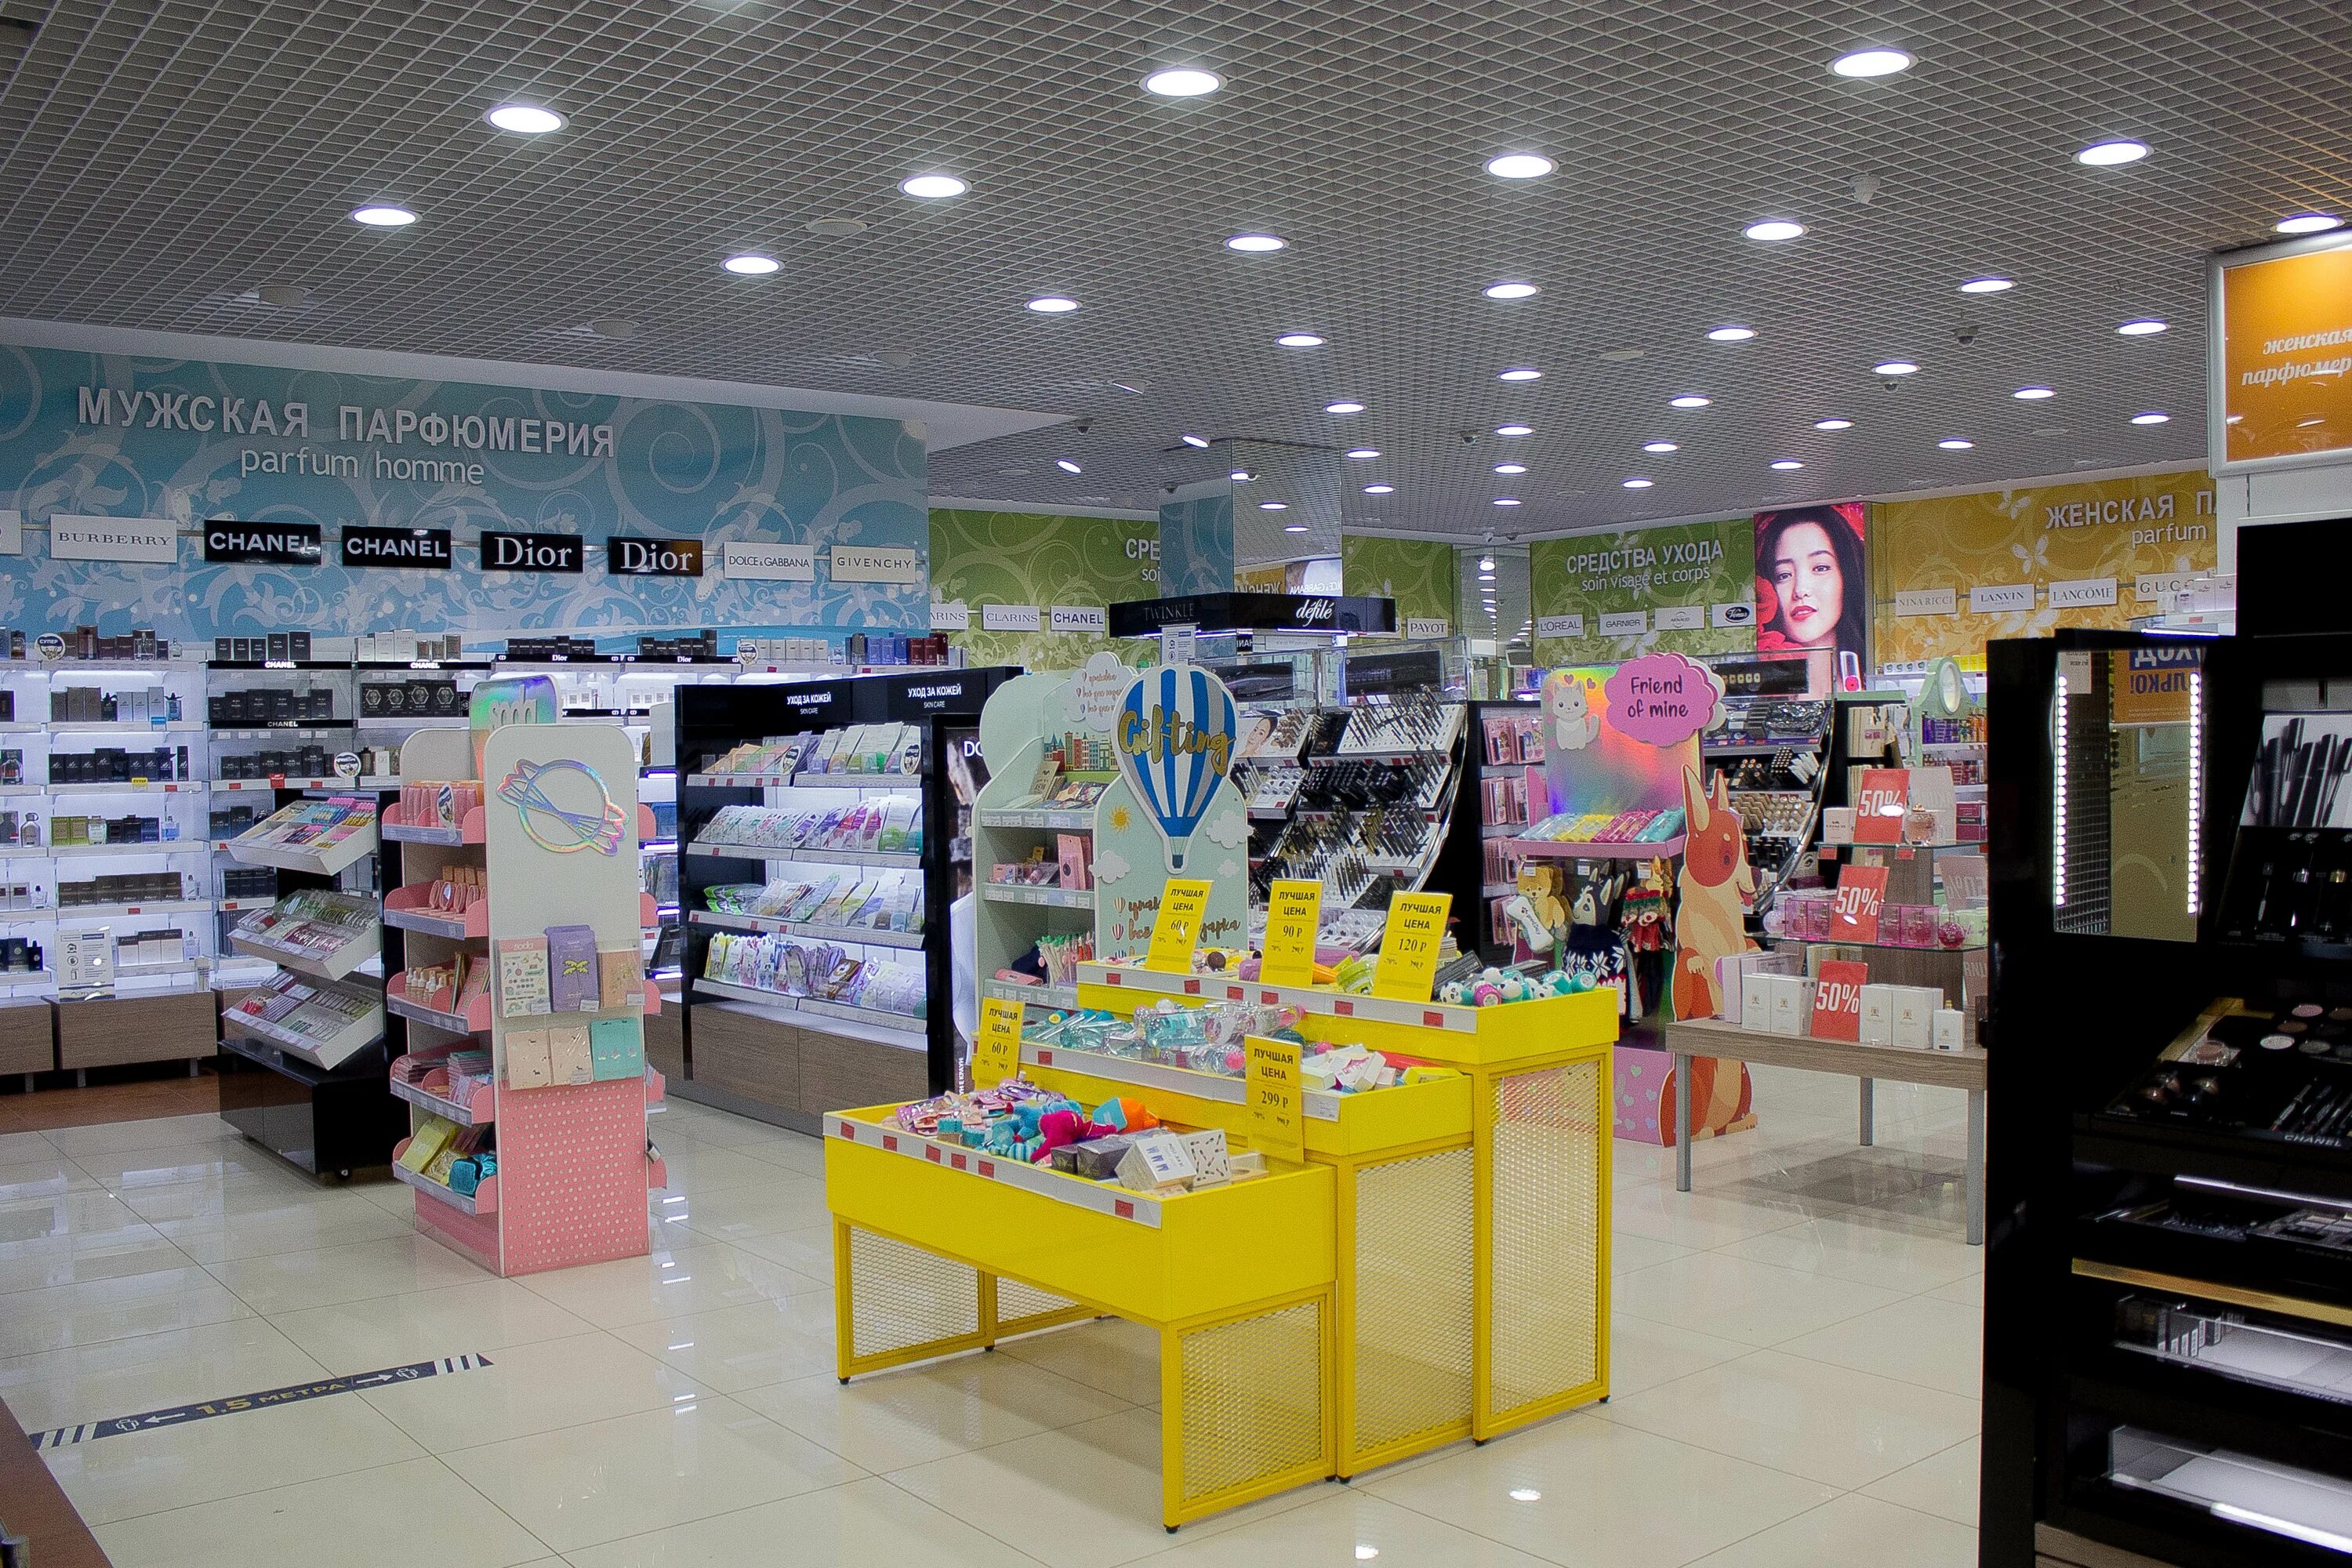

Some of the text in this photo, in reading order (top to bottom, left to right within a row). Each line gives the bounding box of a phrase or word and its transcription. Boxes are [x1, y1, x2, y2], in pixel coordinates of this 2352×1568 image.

[2262, 327, 2352, 355] женская
[78, 387, 615, 457] МУЖСКАЯ ПАРФЮМЕРИЯ
[241, 447, 485, 485] parfum homme
[2045, 495, 2175, 529] ЖЕНСКАЯ
[59, 532, 172, 546] BURBERRY
[209, 532, 315, 552] CHANEL
[2132, 522, 2207, 548] parfum
[347, 537, 448, 557] CHANEL
[494, 537, 573, 568] Dior
[620, 542, 694, 572] Dior
[837, 557, 912, 570] GIVENCHY
[1567, 539, 1724, 575] СРЕДСТВА УХОДА
[1581, 565, 1711, 591] soin visage et corps
[1980, 590, 2025, 603] LANVIN
[2053, 586, 2114, 602] LANCÔME
[1898, 596, 1953, 608] NINA RICCI
[985, 612, 1039, 623] CLARINS
[1054, 612, 1104, 625] CHANEL
[1144, 602, 1195, 621] TWINKLE
[1296, 599, 1335, 626] défilé
[1410, 622, 1446, 633] PAYOT
[265, 660, 297, 669] CHANEL
[410, 661, 441, 670] CHANEL
[552, 654, 568, 662] Dior
[677, 655, 692, 664] Dior
[908, 683, 961, 699] УХОД ЗА КОЖЕЙ
[1630, 676, 1683, 695] Friend
[787, 691, 832, 706] УХОД ЗА КОЖЕЙ
[1627, 699, 1690, 718] of mine
[1117, 703, 1236, 778] Gifting
[1858, 789, 1906, 818] 50%
[1170, 888, 1204, 898] ЛУЧШАЯ
[1279, 891, 1316, 901] ЛУЧШАЯ
[1172, 902, 1194, 912] ЦЕНА
[1399, 902, 1442, 915] ЛУЧШАЯ
[1835, 886, 1880, 916] 50%
[1283, 906, 1307, 916] ЦЕНА
[1171, 919, 1181, 931] 60
[1283, 925, 1294, 937] 90
[1403, 918, 1431, 930] ЦЕНА
[513, 942, 534, 950] soda
[1399, 938, 1418, 952] 120
[1816, 981, 1861, 1014] 50%
[988, 1007, 1018, 1022] ЛУЧШАЯ
[992, 1023, 1011, 1035] ЦЕНА
[992, 1041, 1001, 1054] 60
[1254, 1047, 1294, 1065] ЛУЧШАЯ
[1261, 1066, 1287, 1080] ЦЕНА
[1261, 1090, 1279, 1107] 299
[2284, 1134, 2342, 1148] CHANEL
[258, 1382, 347, 1403] МЕТРА
